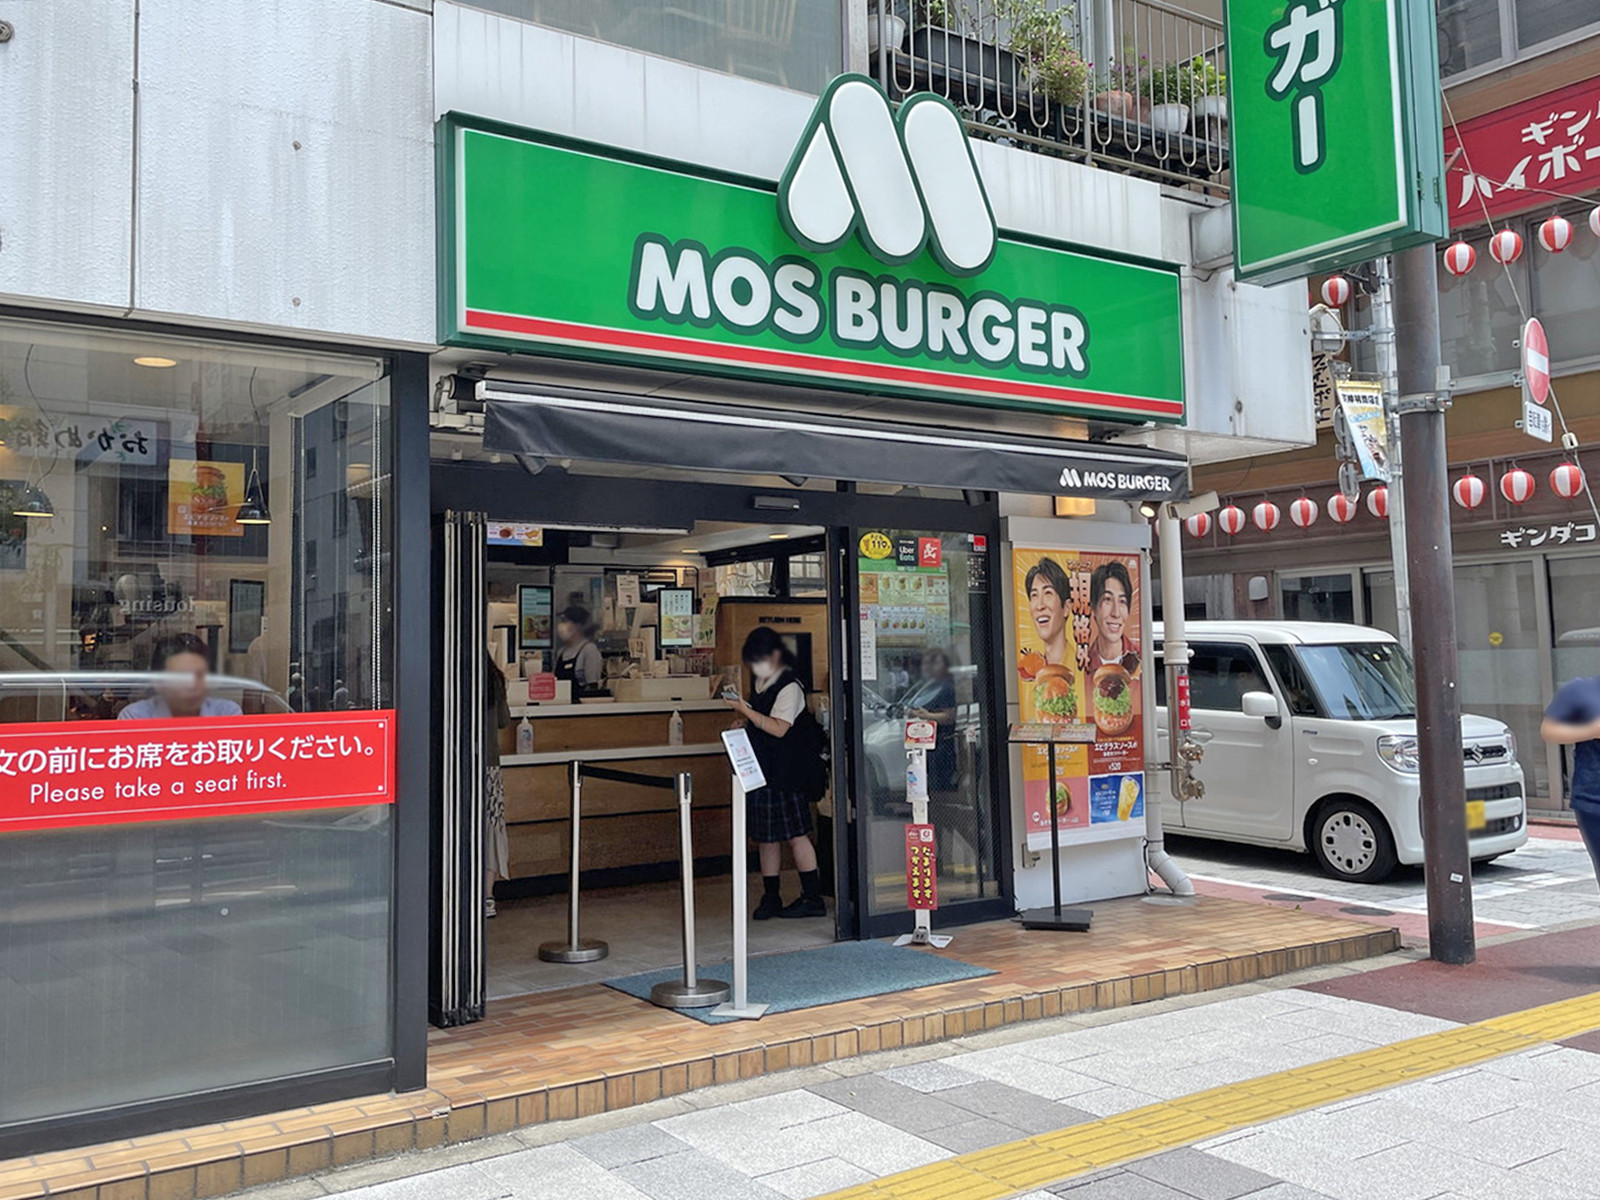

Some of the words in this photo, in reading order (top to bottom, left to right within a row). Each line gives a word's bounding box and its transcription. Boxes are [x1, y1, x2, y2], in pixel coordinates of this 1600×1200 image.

[1521, 100, 1600, 145] ギン
[635, 240, 820, 336] MOS
[835, 275, 1086, 374] BURGER
[1083, 471, 1116, 489] MOS
[1117, 473, 1172, 492] BURGER
[1500, 521, 1597, 549] ギンダコ
[0, 734, 374, 776] 文の前にお席をお取りください。
[30, 781, 104, 804] Please
[115, 776, 161, 798] take
[171, 781, 184, 795] a
[195, 774, 238, 794] seat
[246, 769, 287, 790] first.
